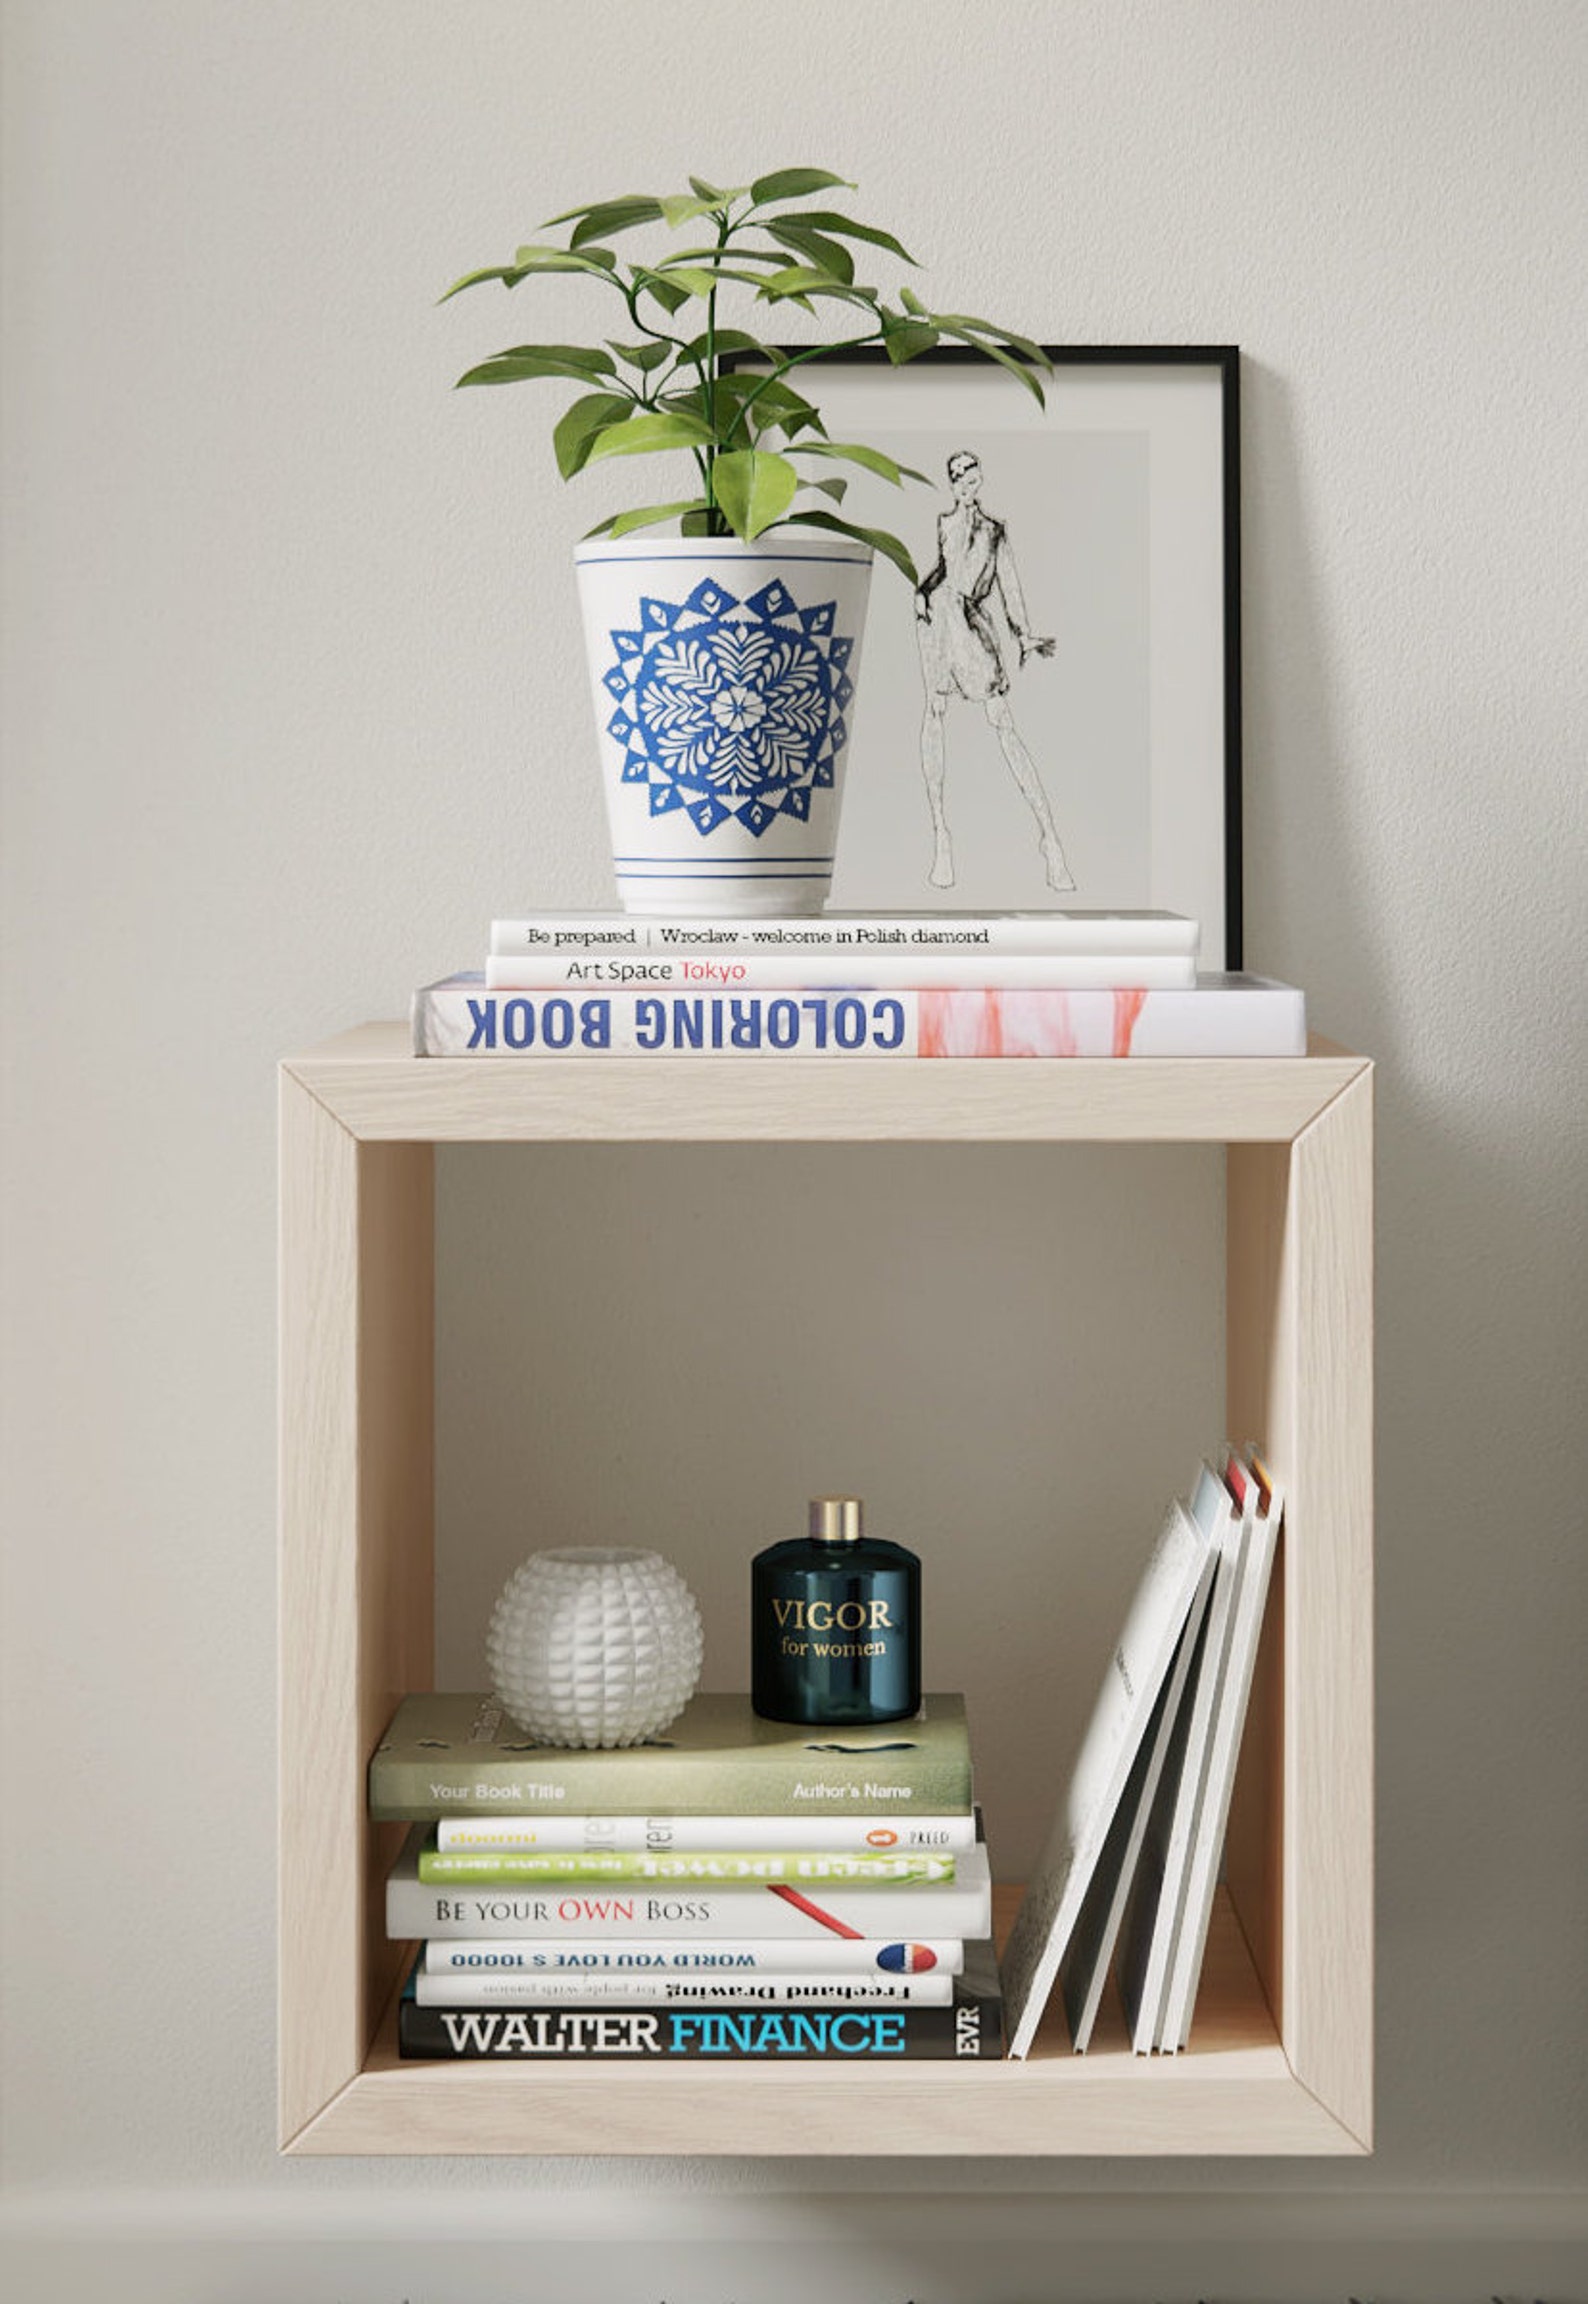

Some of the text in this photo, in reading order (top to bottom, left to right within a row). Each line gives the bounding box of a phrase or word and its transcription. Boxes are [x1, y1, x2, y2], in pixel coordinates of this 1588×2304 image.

[528, 929, 636, 947] Be prepared
[660, 929, 990, 944] Wroclaw welcome in Polish diamond
[566, 961, 746, 983] Art Space Tokyo
[466, 998, 905, 1050] COLORING BOOK
[772, 1599, 893, 1631] VIGOR
[782, 1637, 886, 1657] for women
[430, 1784, 566, 1799] Your Book Title
[793, 1783, 912, 1799] Author's Name
[436, 1900, 711, 1921] BE YOUR OWN BOSS
[451, 1954, 524, 1967] 10000
[554, 1954, 610, 1967] LOVE
[617, 1954, 666, 1967] YOU
[673, 1954, 756, 1967] WORLD
[665, 1984, 910, 2000] Freehand Drawing
[440, 2013, 906, 2053] WALTER FINANCE
[955, 2006, 980, 2055] EVR
